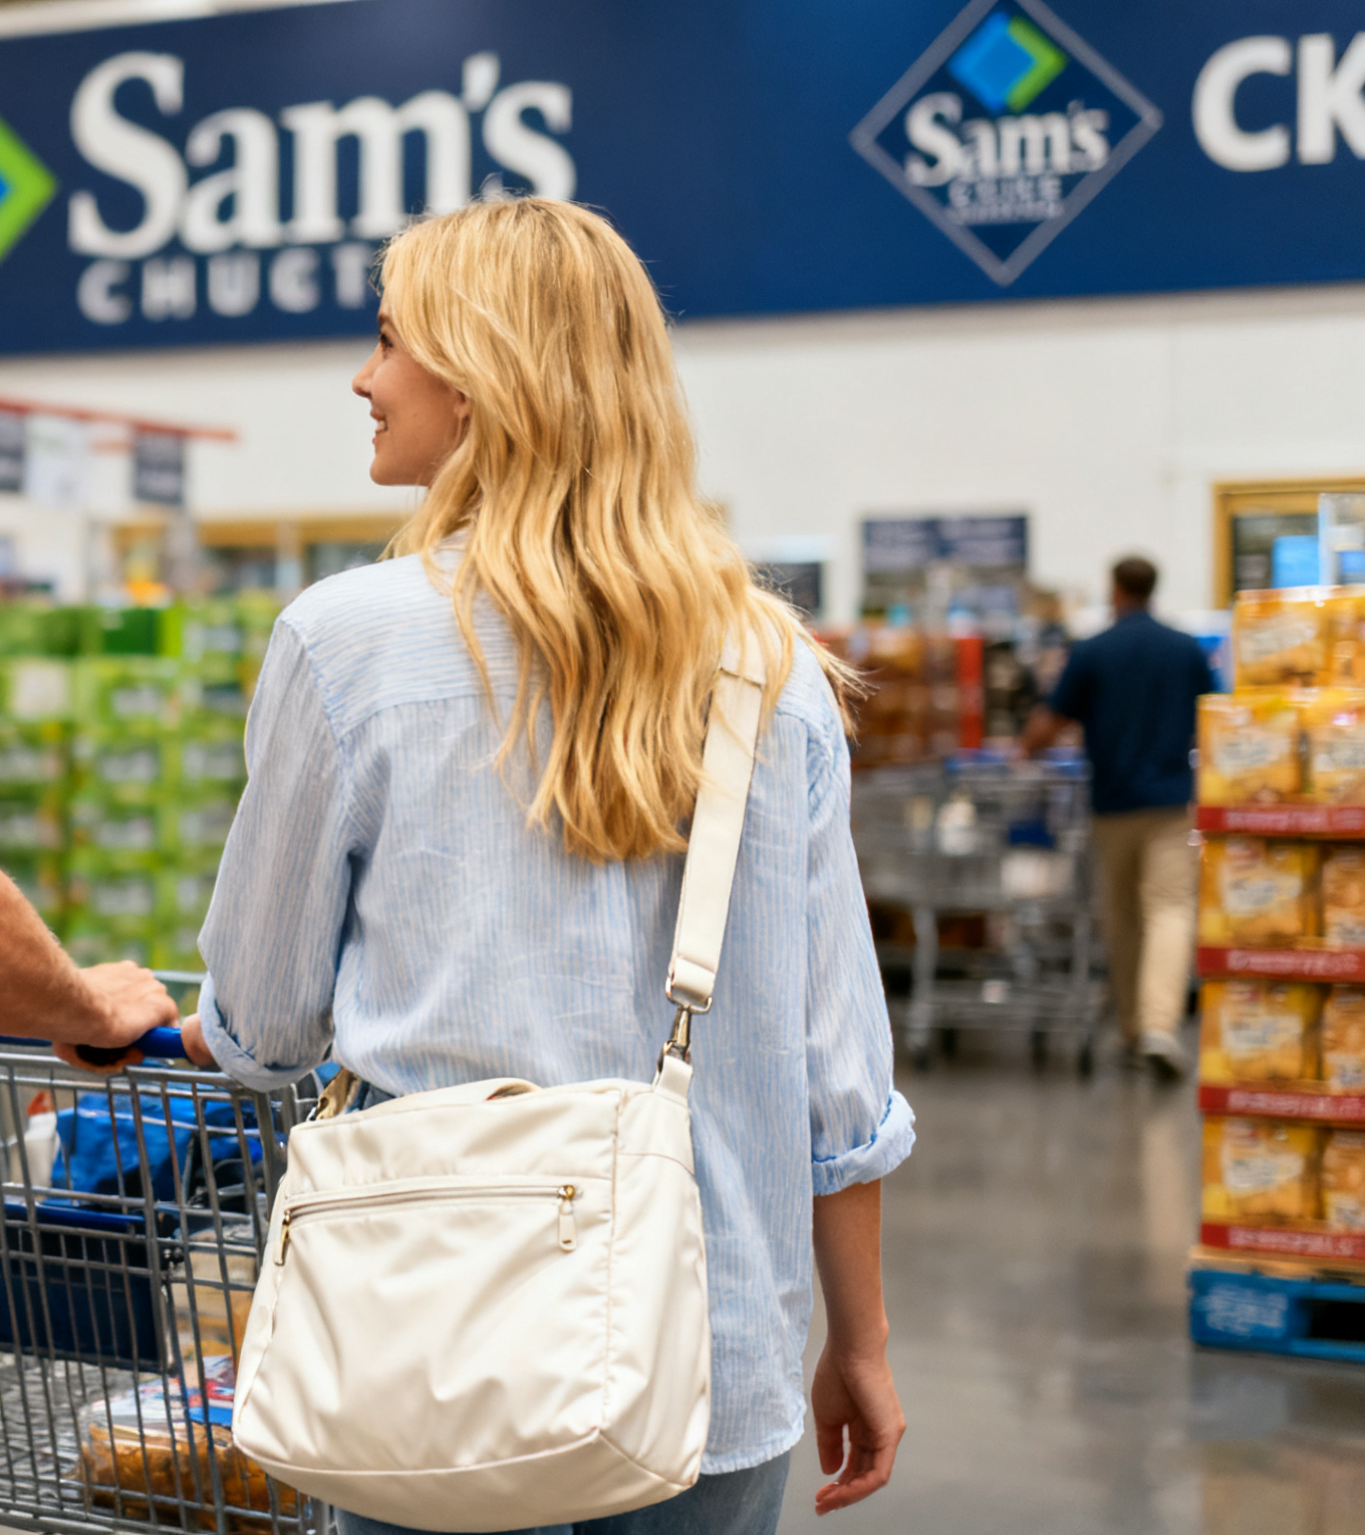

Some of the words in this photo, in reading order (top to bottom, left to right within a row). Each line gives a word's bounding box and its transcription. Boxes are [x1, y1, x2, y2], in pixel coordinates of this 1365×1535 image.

[68, 50, 577, 260] Sam's
[905, 91, 1110, 187] Sam's
[1191, 31, 1365, 173] CK
